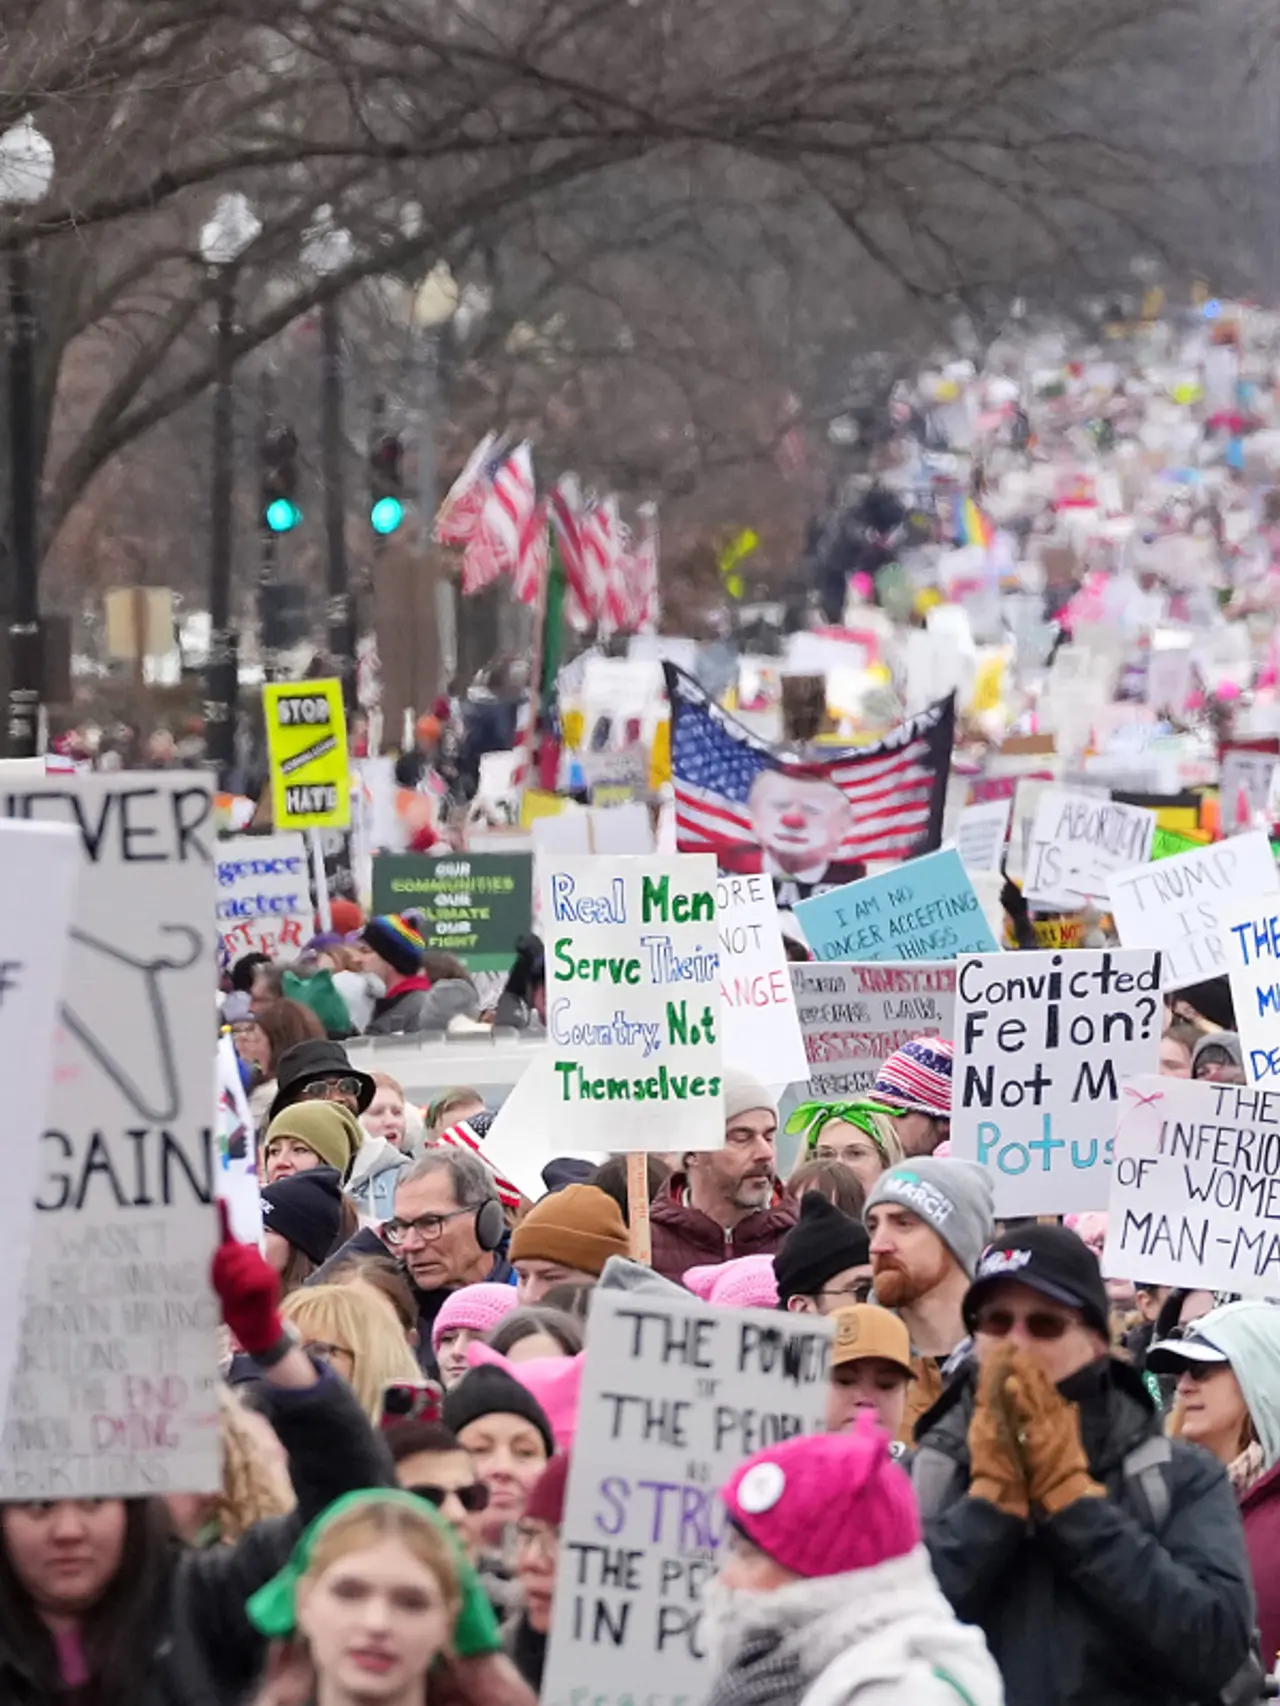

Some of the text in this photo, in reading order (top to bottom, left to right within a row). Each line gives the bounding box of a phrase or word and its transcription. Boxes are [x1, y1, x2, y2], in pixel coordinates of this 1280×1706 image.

[278, 697, 330, 724] STOP
[8, 784, 215, 863] VER
[286, 787, 338, 814] HATE
[552, 874, 715, 924] Real Men
[855, 899, 881, 919] AM
[888, 885, 915, 908] NO
[1119, 850, 1238, 911] TRUMP
[812, 893, 980, 961] LONGER ACCEPTING
[901, 927, 959, 961] THINGS
[1176, 902, 1217, 936] IS
[554, 935, 720, 985] Serve Their
[959, 951, 1162, 1004] Convicted
[667, 1000, 717, 1046] Not
[964, 997, 1157, 1055] Felon?
[554, 1061, 722, 1101] Themselves
[962, 1058, 1118, 1108] Not M
[976, 1113, 1116, 1175] Potus
[1117, 1157, 1158, 1189] OF
[883, 1178, 955, 1225] MARCH
[615, 1311, 719, 1368] THE
[601, 1393, 694, 1448] THE
[568, 1542, 645, 1592] THE
[572, 1596, 631, 1648] IN
